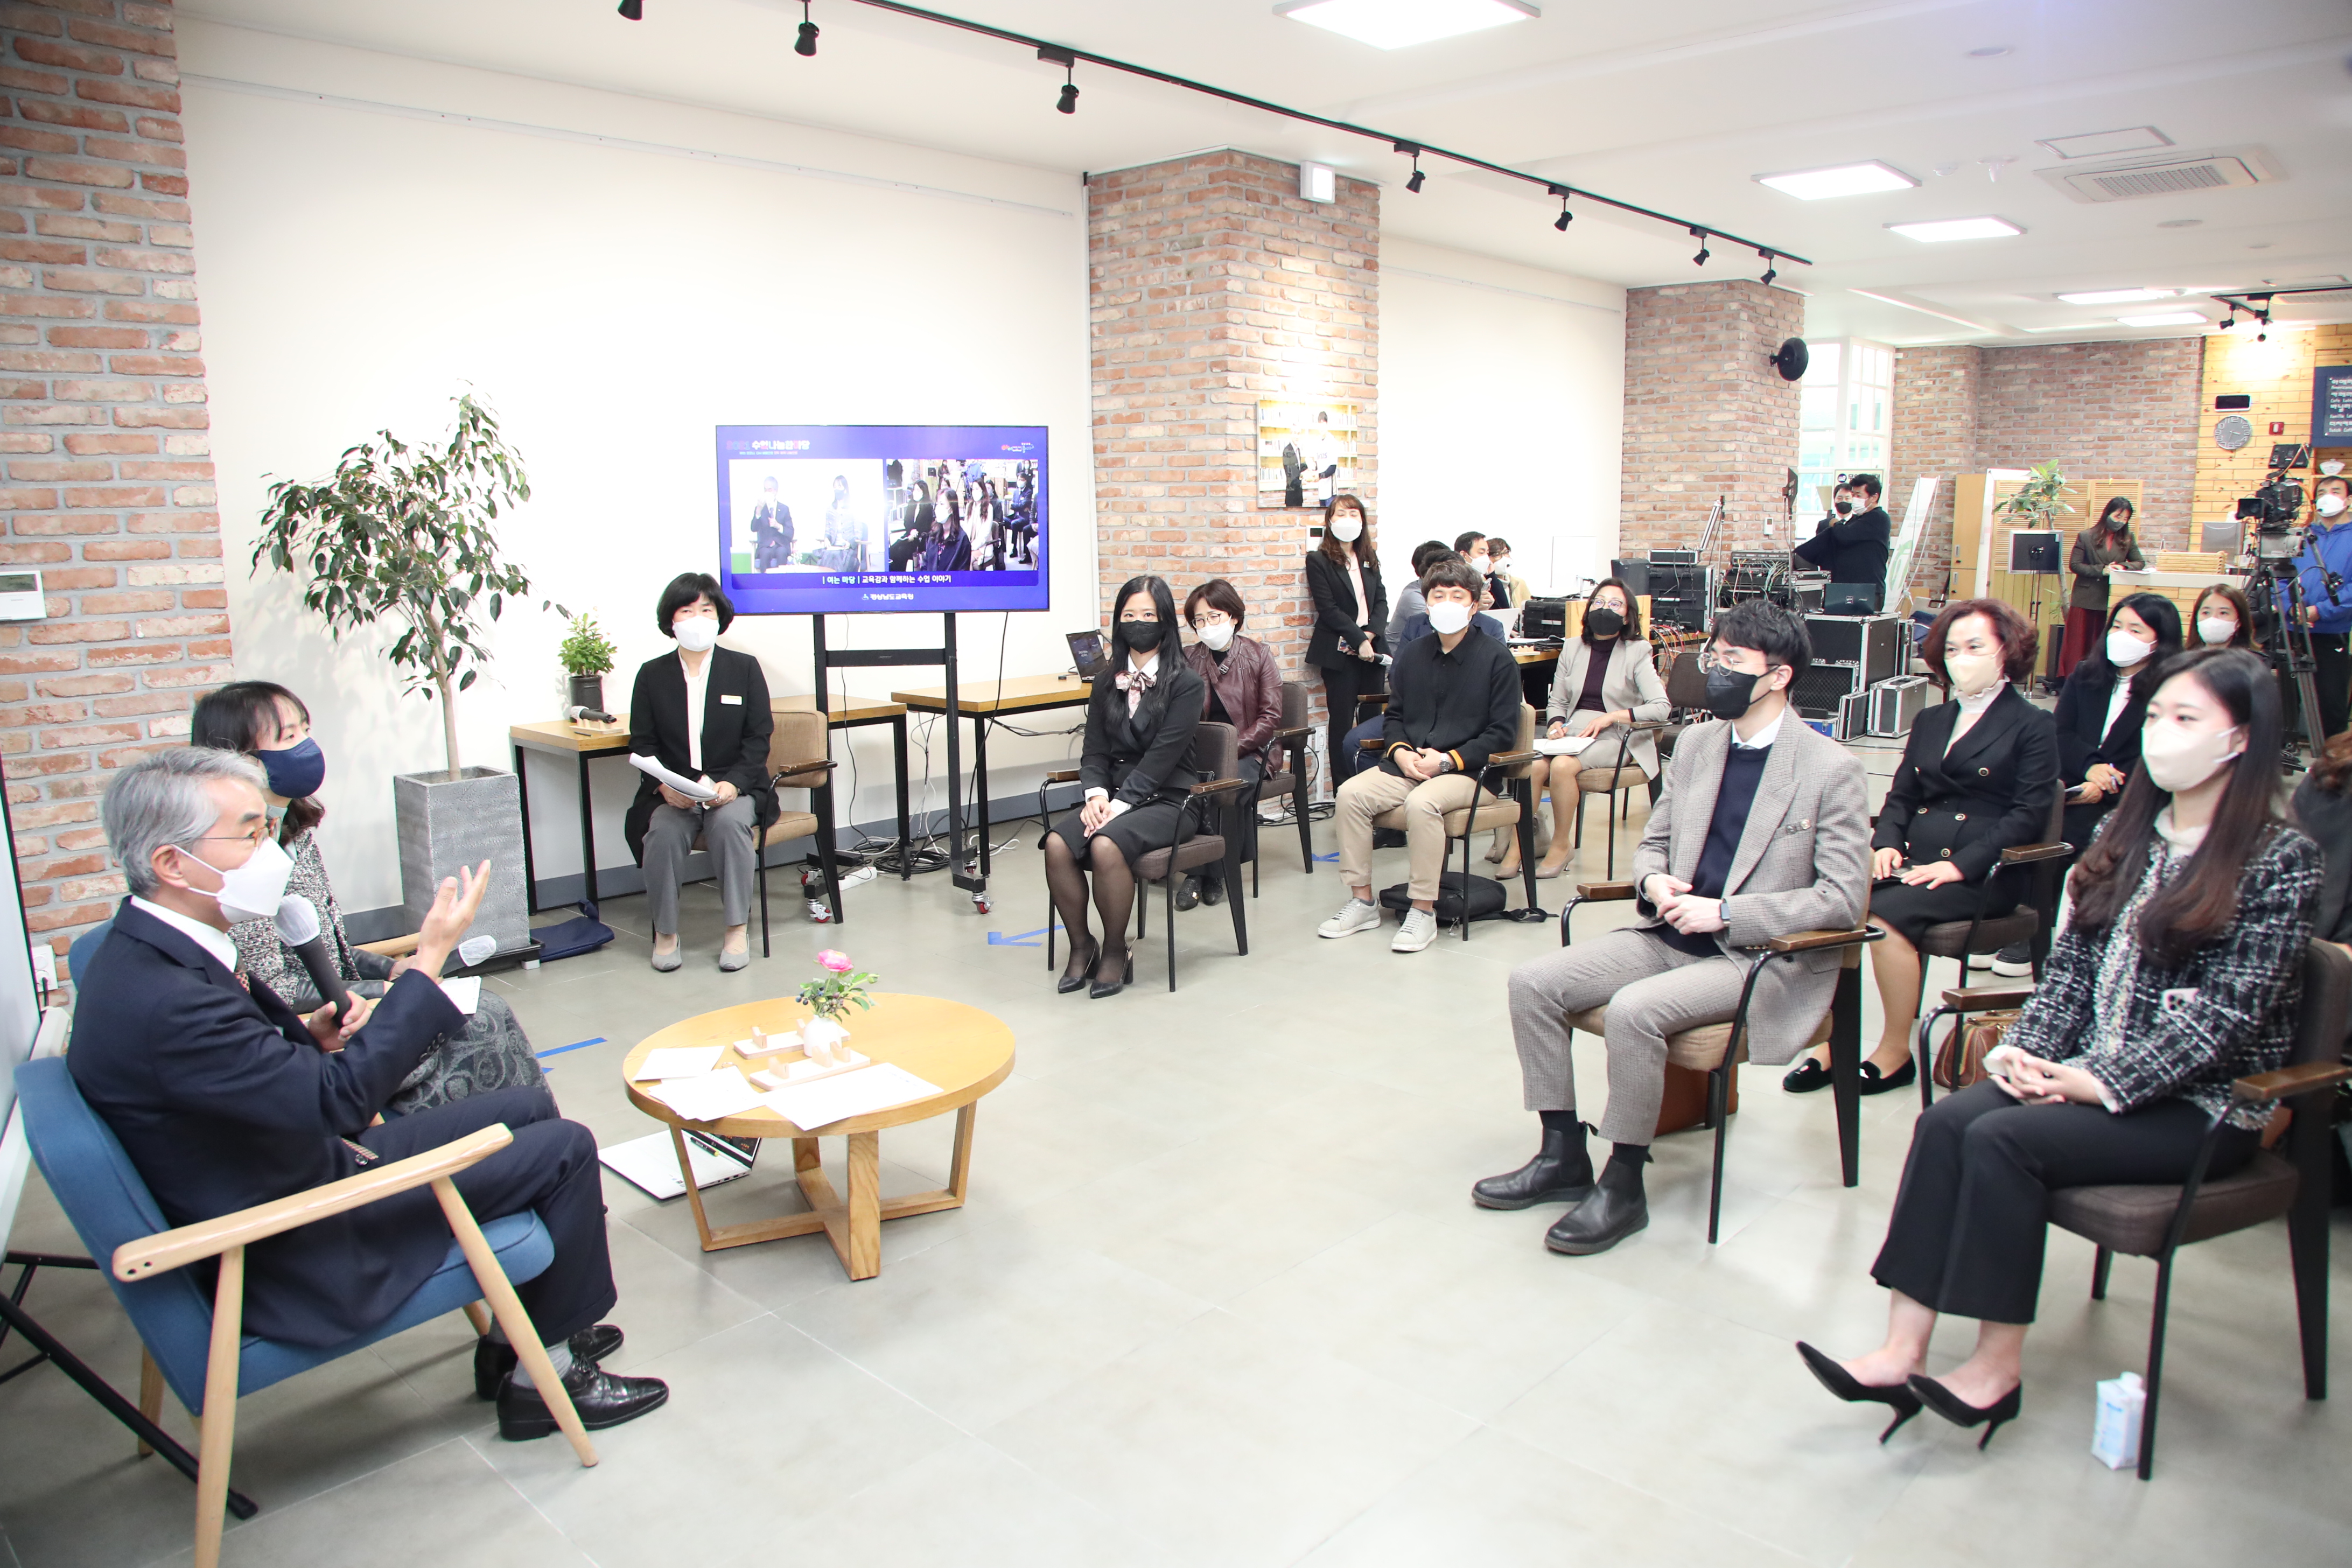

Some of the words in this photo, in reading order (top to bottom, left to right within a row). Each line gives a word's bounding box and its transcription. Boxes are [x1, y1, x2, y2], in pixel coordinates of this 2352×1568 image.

[2330, 404, 2352, 412] 바닐라
[827, 576, 840, 584] 여는
[842, 576, 856, 584] 마당
[862, 576, 887, 584] 교육감과
[890, 576, 915, 584] 함께하는
[917, 575, 930, 583] 수업
